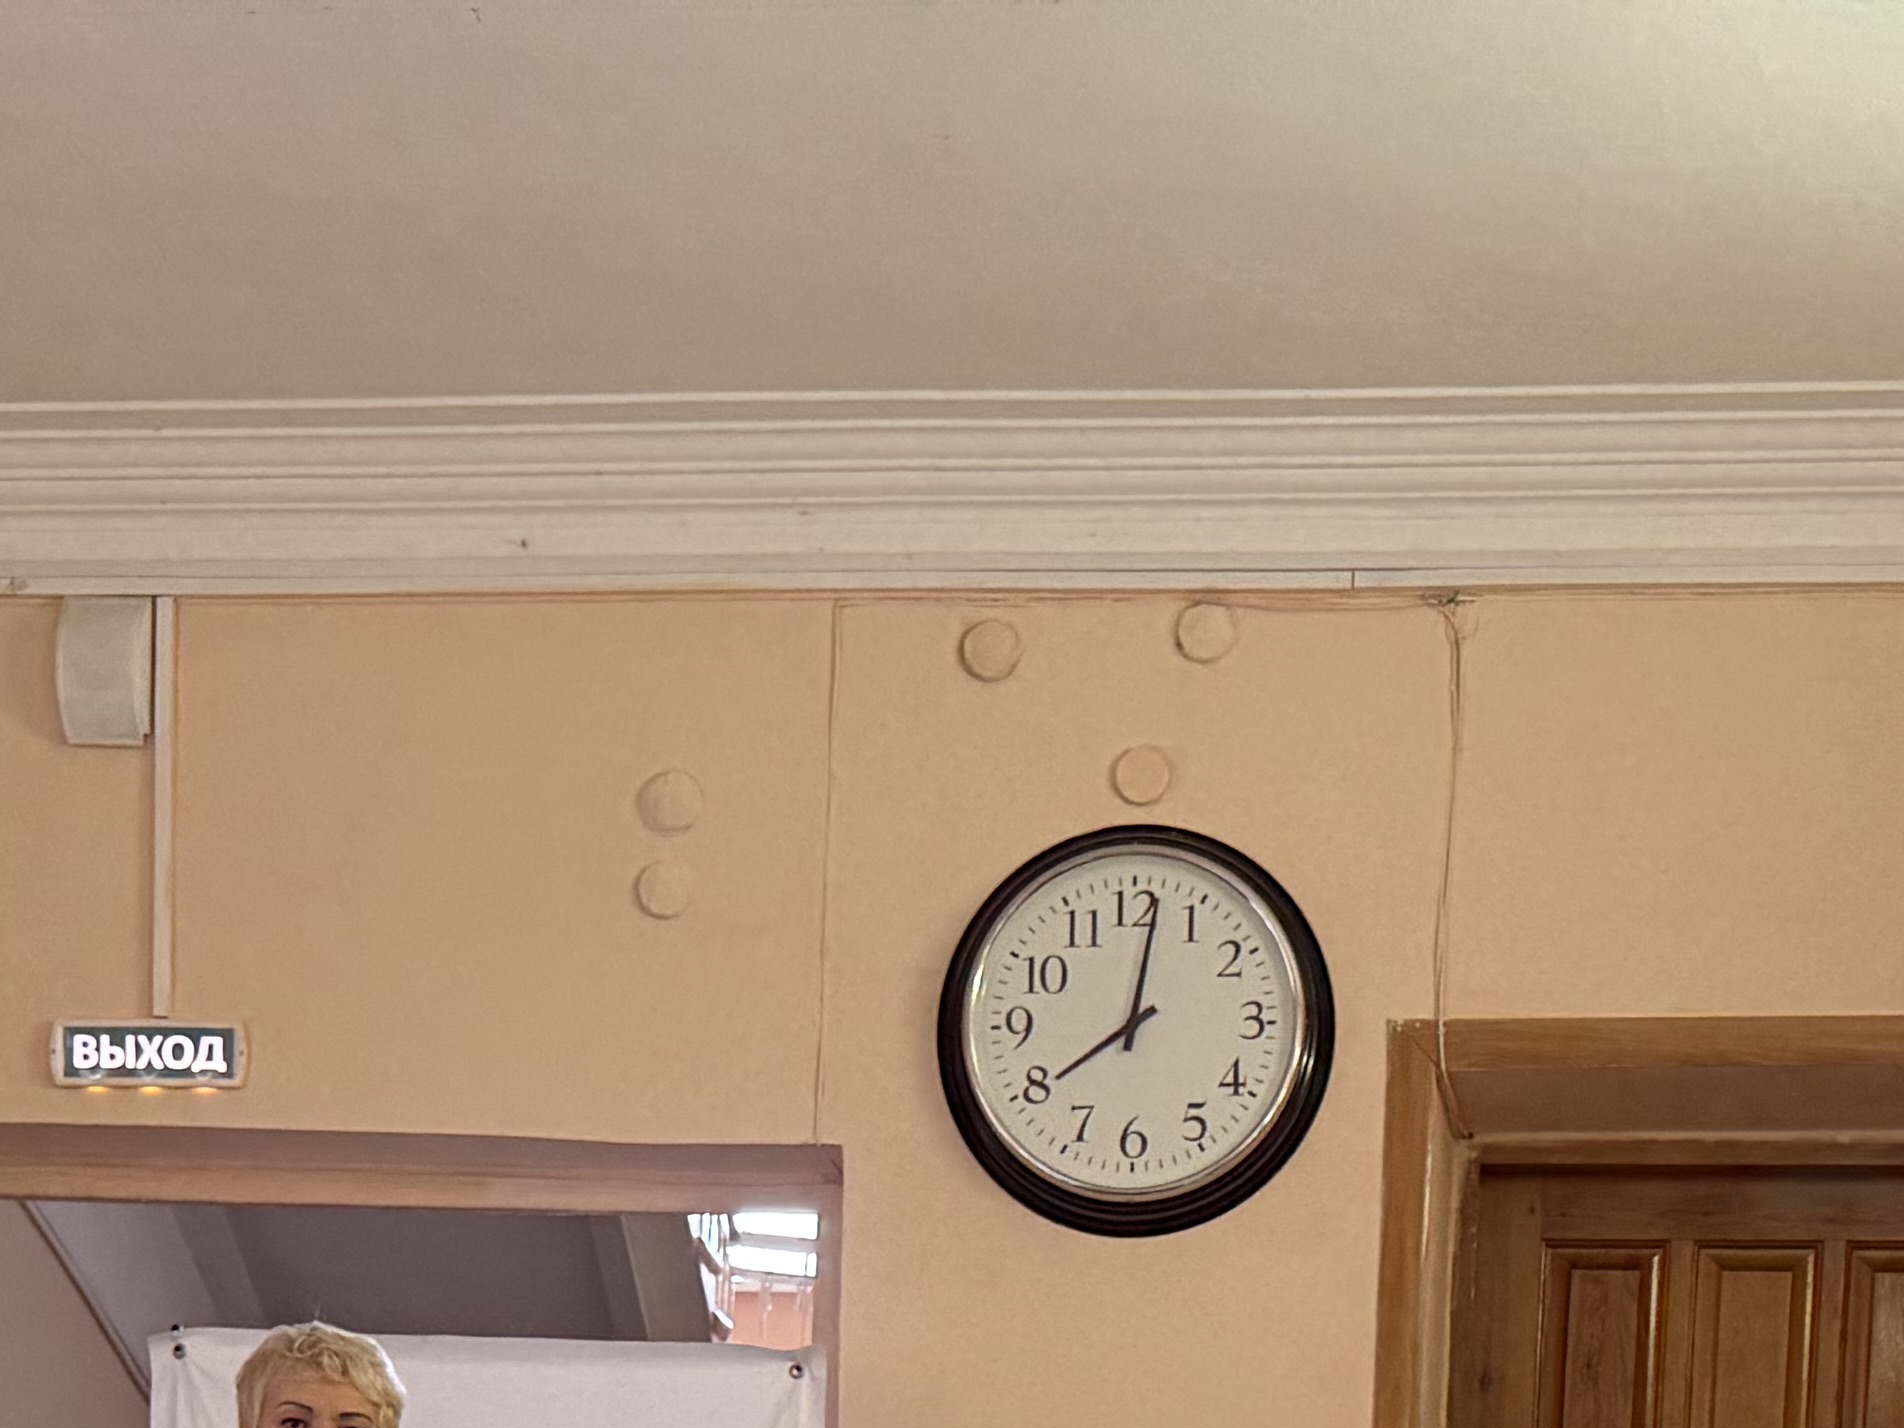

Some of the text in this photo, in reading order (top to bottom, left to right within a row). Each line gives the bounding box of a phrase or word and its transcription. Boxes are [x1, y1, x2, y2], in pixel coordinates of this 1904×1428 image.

[1063, 908, 1102, 949] 11
[1112, 889, 1157, 928] 12
[1183, 904, 1199, 944] 1
[1023, 954, 1069, 995] 10
[1216, 940, 1243, 978] 2
[1005, 1006, 1034, 1050] 9
[1240, 1000, 1266, 1040] 3
[72, 1033, 227, 1073] ВЫХОД
[1022, 1065, 1051, 1105] 8
[1218, 1057, 1247, 1097] 4
[1070, 1104, 1095, 1143] 7
[1119, 1115, 1148, 1159] 6
[1181, 1101, 1207, 1142] 5
